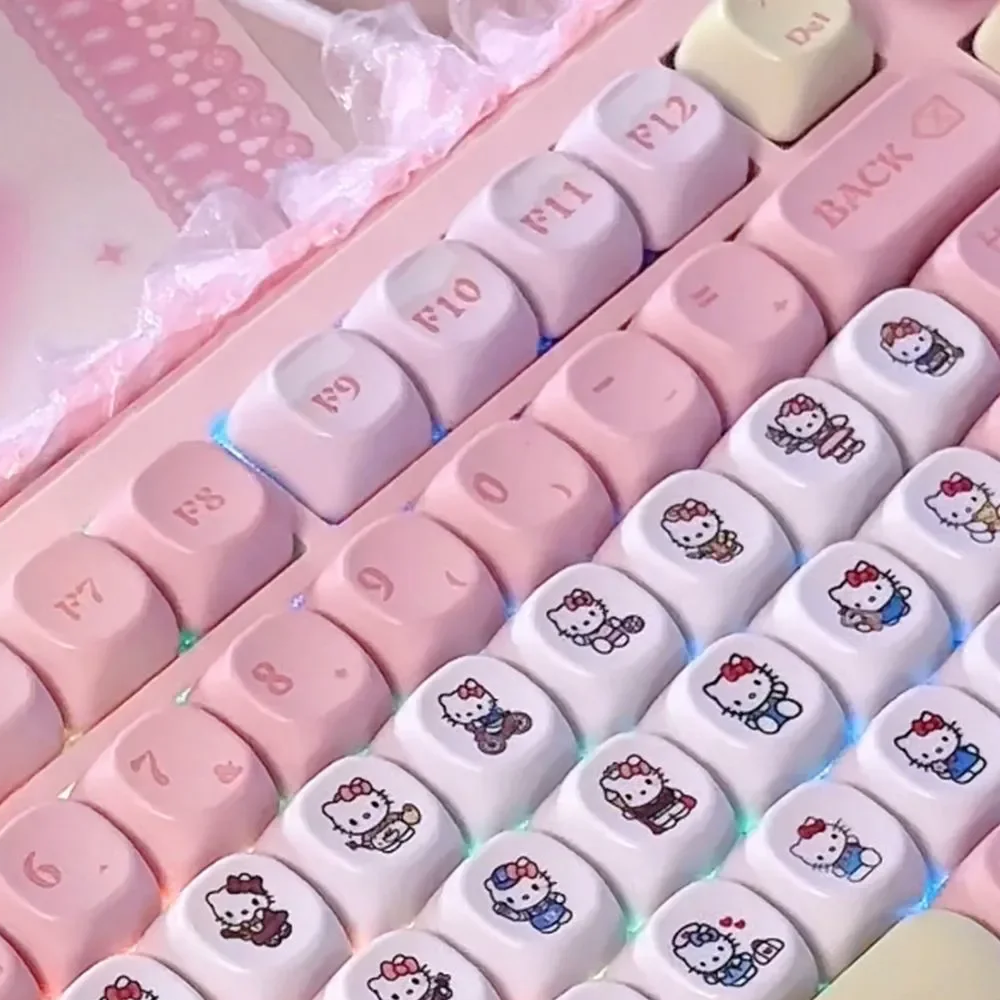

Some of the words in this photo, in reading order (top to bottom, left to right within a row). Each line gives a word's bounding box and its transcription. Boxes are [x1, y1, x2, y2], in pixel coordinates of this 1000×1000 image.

[785, 12, 830, 46] Del
[625, 96, 698, 150] F12
[812, 143, 913, 230] BACK
[520, 181, 593, 235] F11
[412, 278, 481, 333] F10
[311, 376, 360, 413] F9
[173, 486, 225, 527] F8
[473, 472, 508, 504] 0
[54, 577, 103, 621] F7
[356, 566, 394, 602] 9
[252, 662, 294, 696] 8
[130, 750, 170, 786] 7
[23, 851, 62, 889] 6
